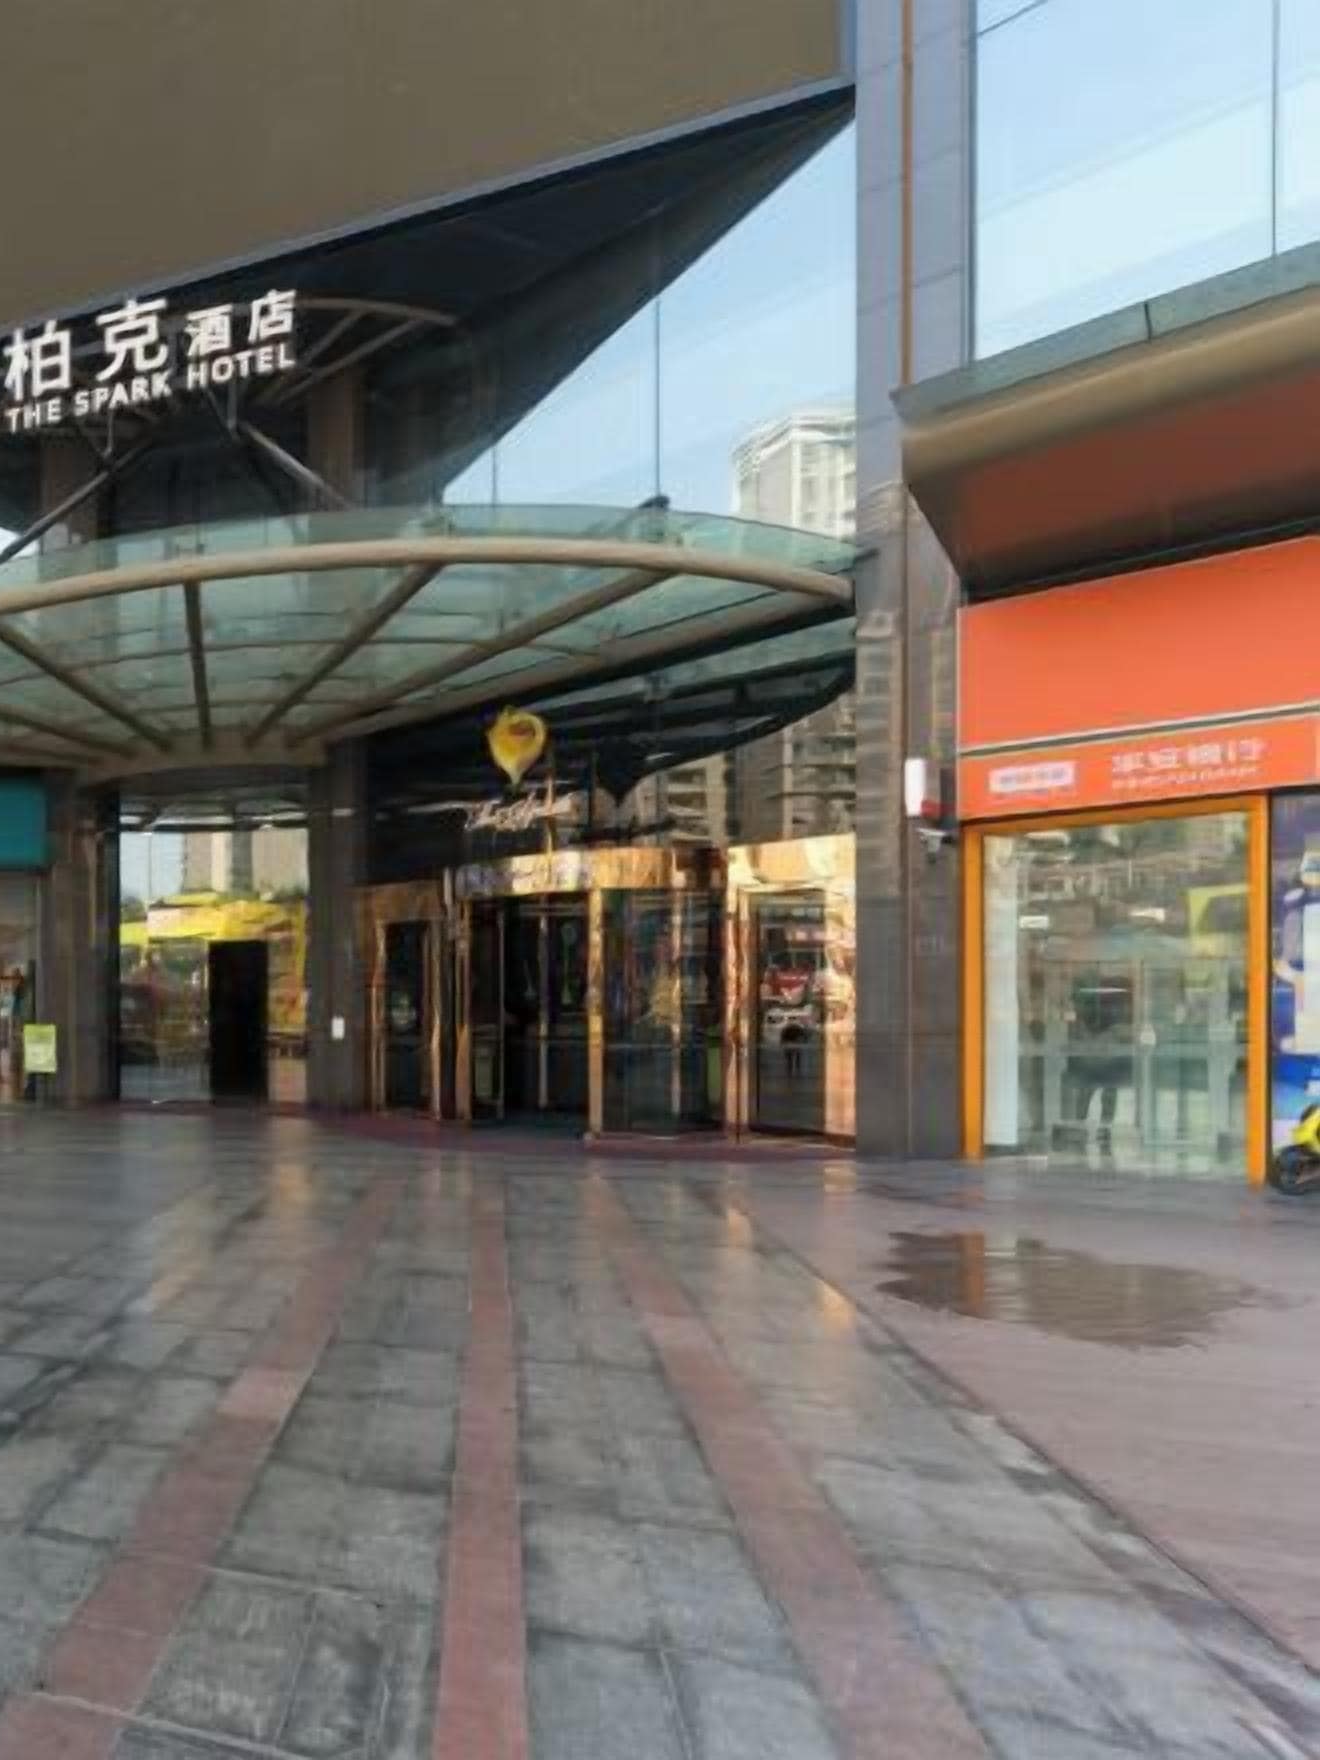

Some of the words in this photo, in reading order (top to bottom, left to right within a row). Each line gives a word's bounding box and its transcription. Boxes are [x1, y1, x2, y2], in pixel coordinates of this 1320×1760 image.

[5, 396, 62, 433] THE
[74, 370, 172, 416] SPARK
[187, 344, 297, 391] HOTEL
